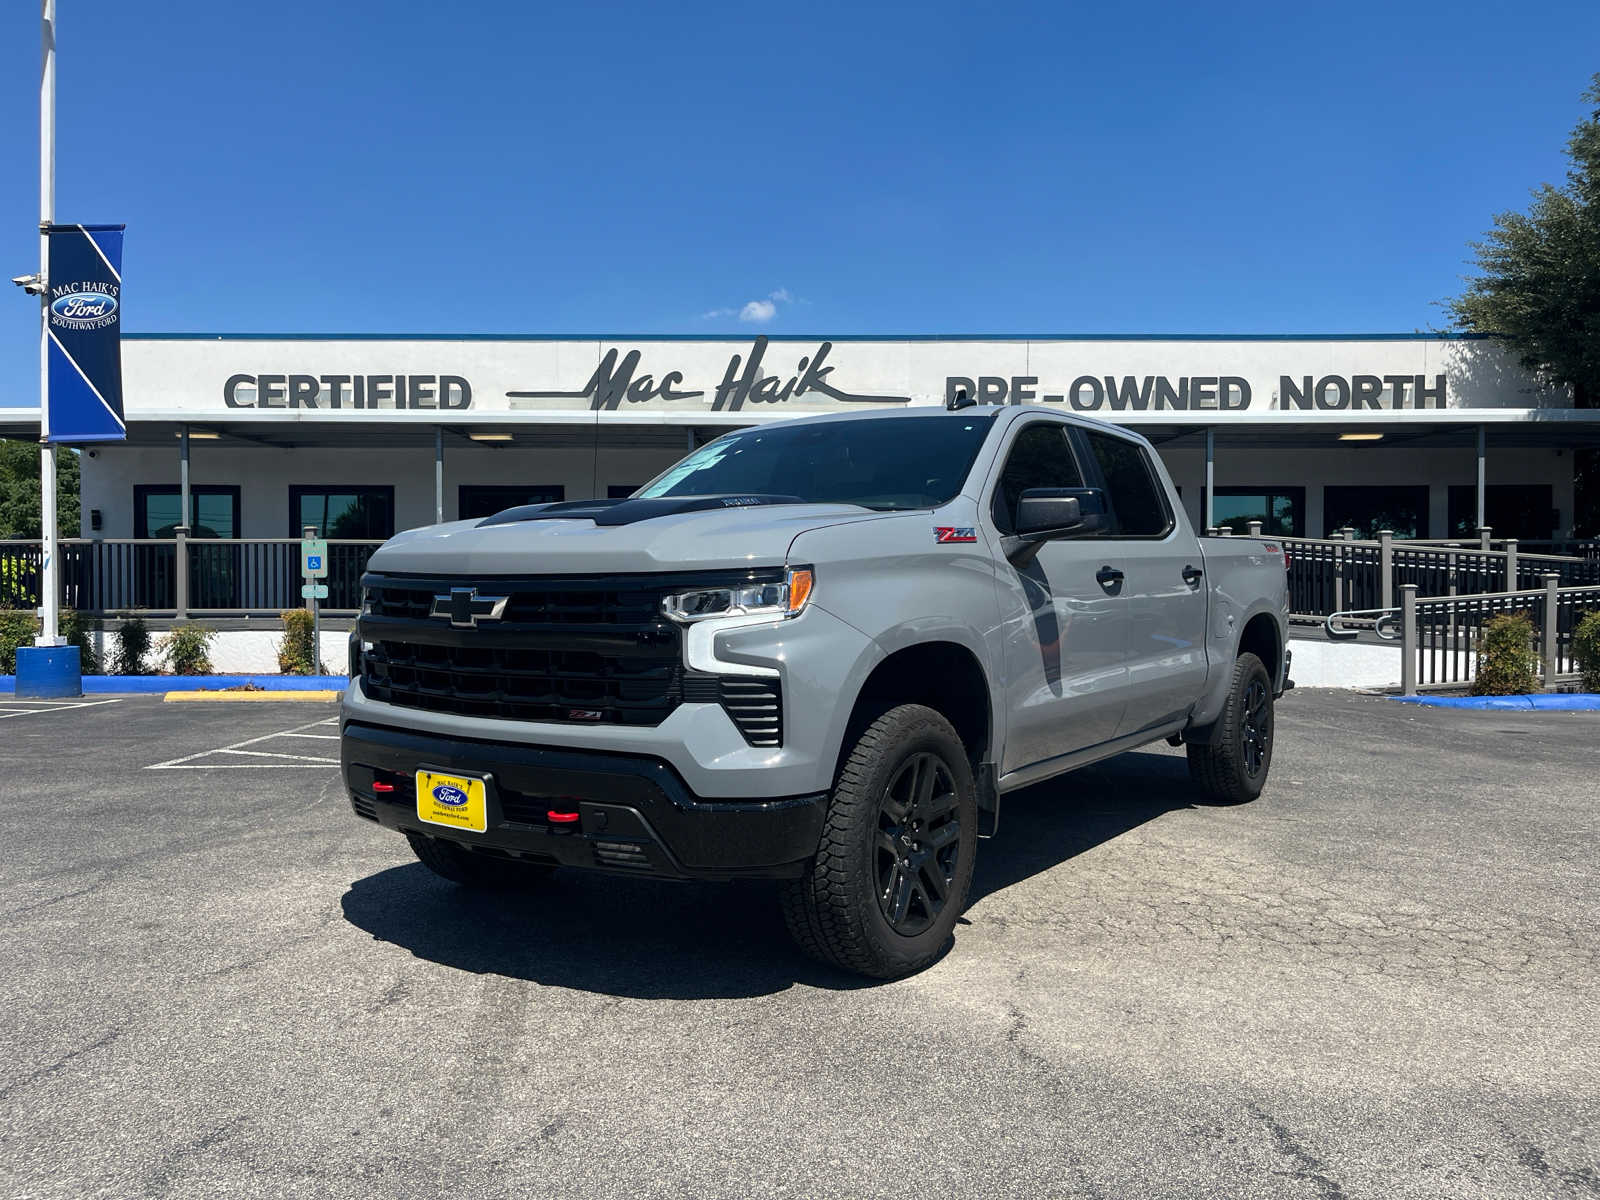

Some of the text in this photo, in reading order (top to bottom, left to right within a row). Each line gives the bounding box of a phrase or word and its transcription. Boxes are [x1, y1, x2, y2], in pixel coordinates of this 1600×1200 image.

[52, 281, 119, 298] MAC HAIK'S
[63, 297, 105, 317] Ford
[51, 314, 117, 330] SOUTHWAY FORD
[710, 335, 911, 411] Haik
[223, 374, 472, 409] CERTIFIED
[946, 375, 1447, 411] PRE-OWNED NORTH
[933, 527, 977, 543] Z71
[439, 788, 461, 803] Ford
